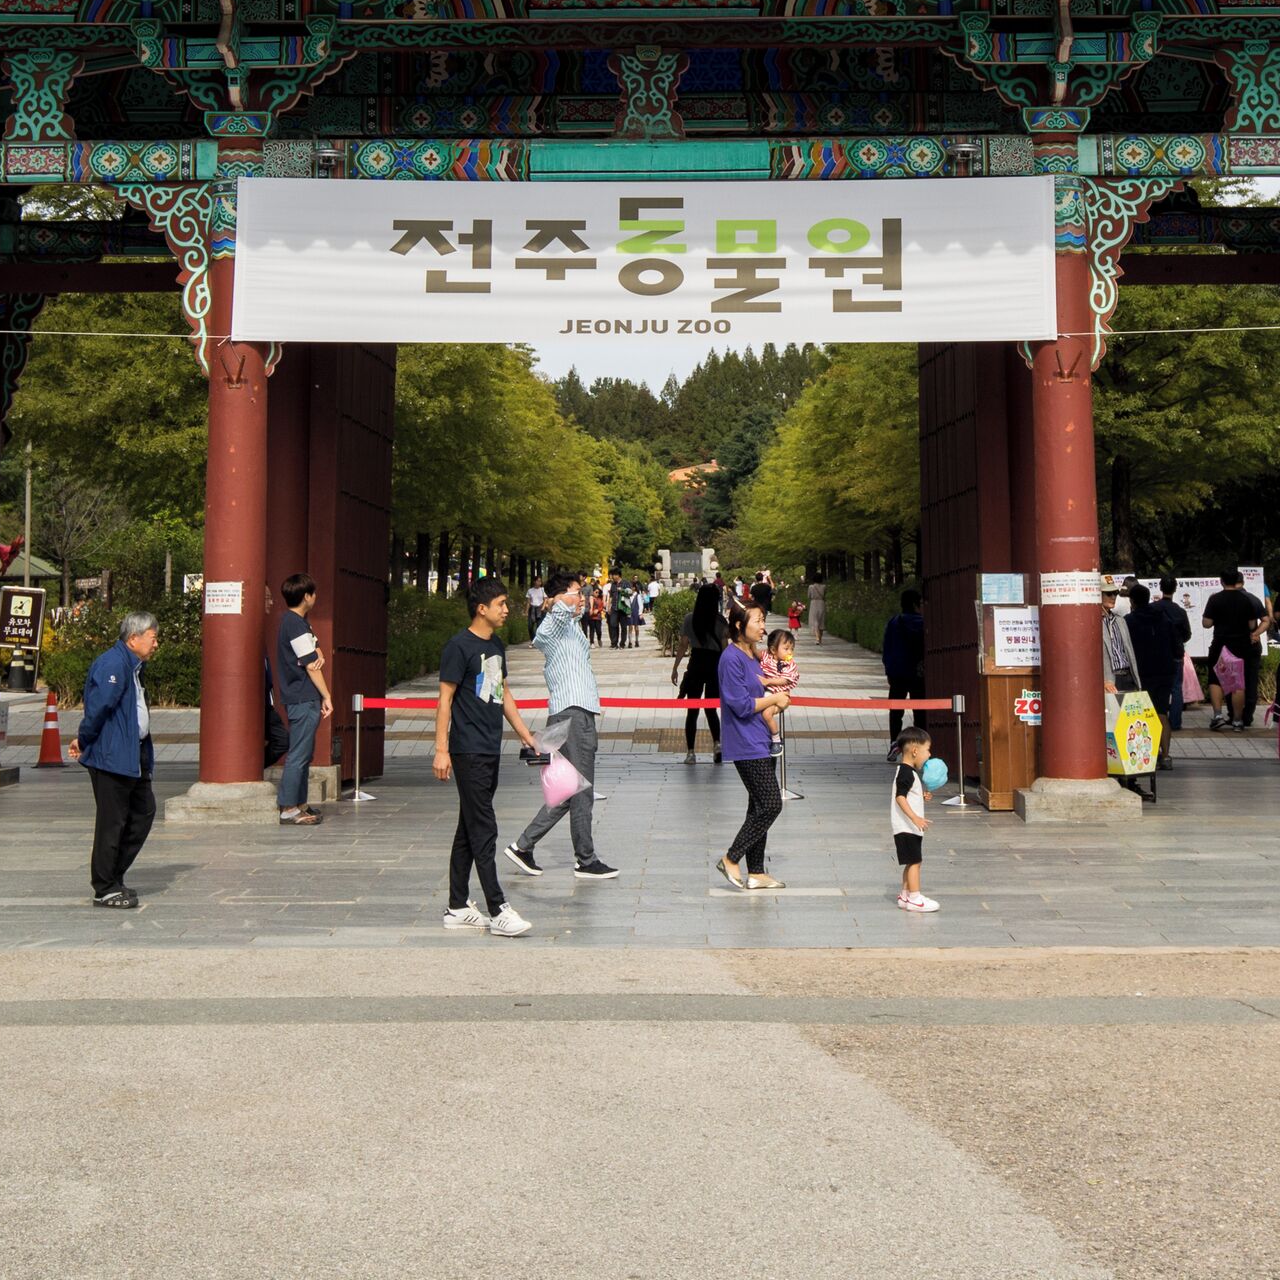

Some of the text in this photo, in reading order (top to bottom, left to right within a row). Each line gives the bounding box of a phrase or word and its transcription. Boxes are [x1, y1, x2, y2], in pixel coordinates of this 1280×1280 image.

[389, 197, 903, 313] 전주동물원
[559, 319, 732, 335] JEONJU ZOO
[8, 617, 31, 627] 유모차
[4, 626, 33, 637] 무료대여
[1023, 690, 1041, 699] Jeon
[1016, 700, 1041, 714] ZO
